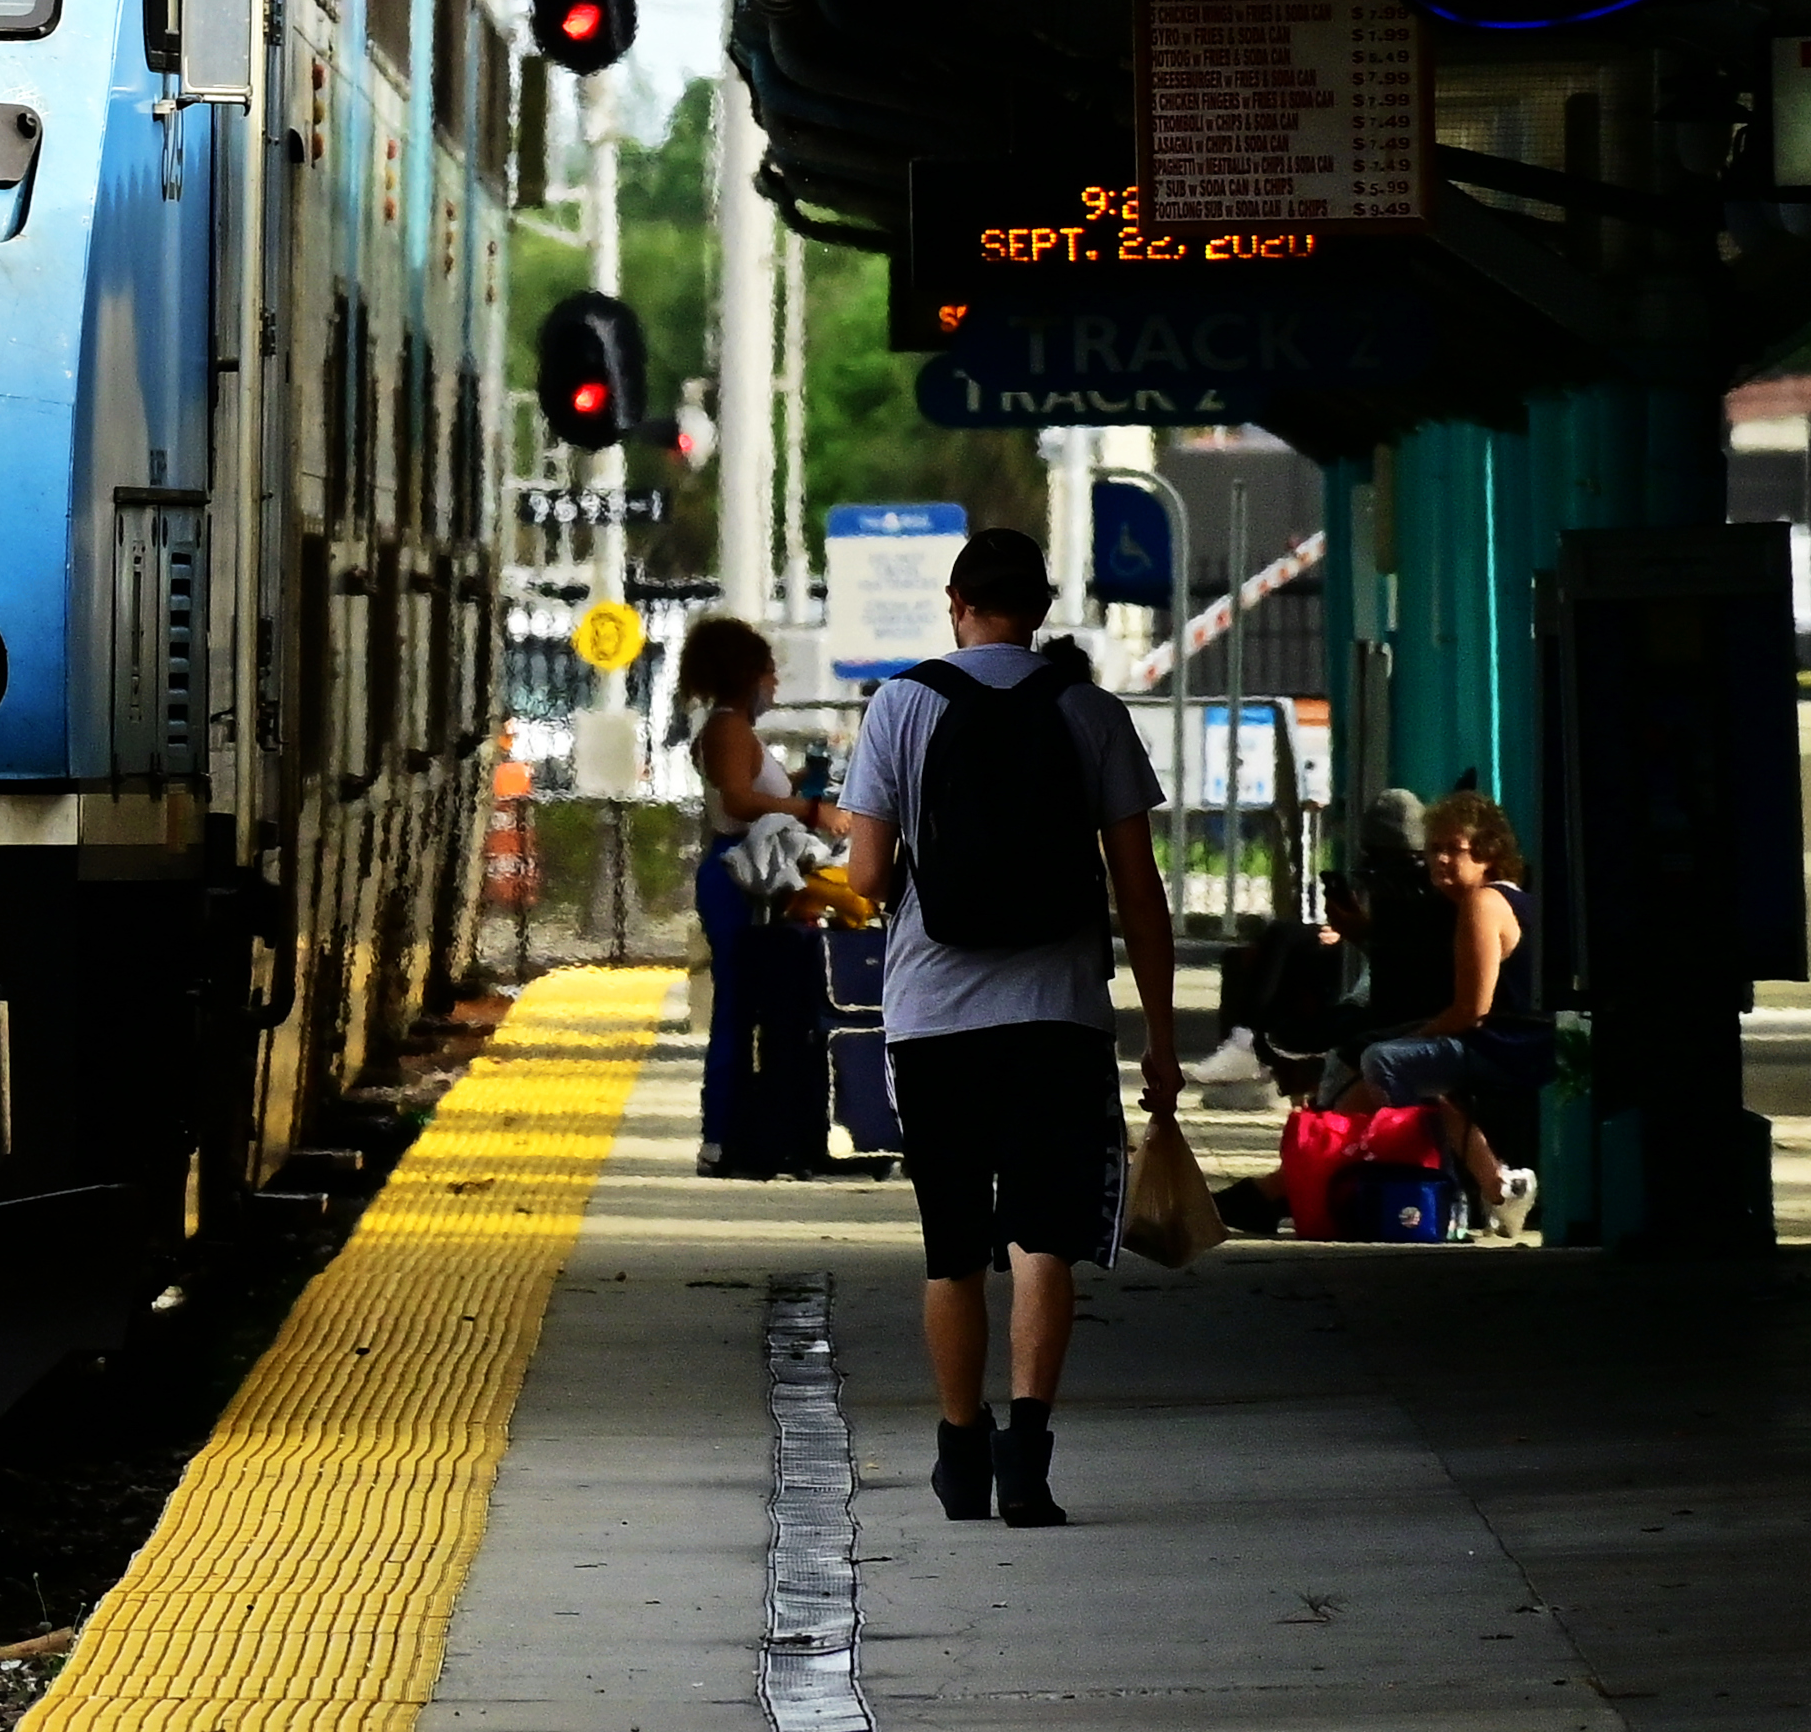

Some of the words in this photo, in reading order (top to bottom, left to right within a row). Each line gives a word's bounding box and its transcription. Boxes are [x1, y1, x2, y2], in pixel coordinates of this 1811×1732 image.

[1154, 137, 1193, 154] ASAGNA
[980, 227, 1098, 262] SEPT.
[1008, 310, 1312, 377] TRACK
[1350, 310, 1383, 370] 2
